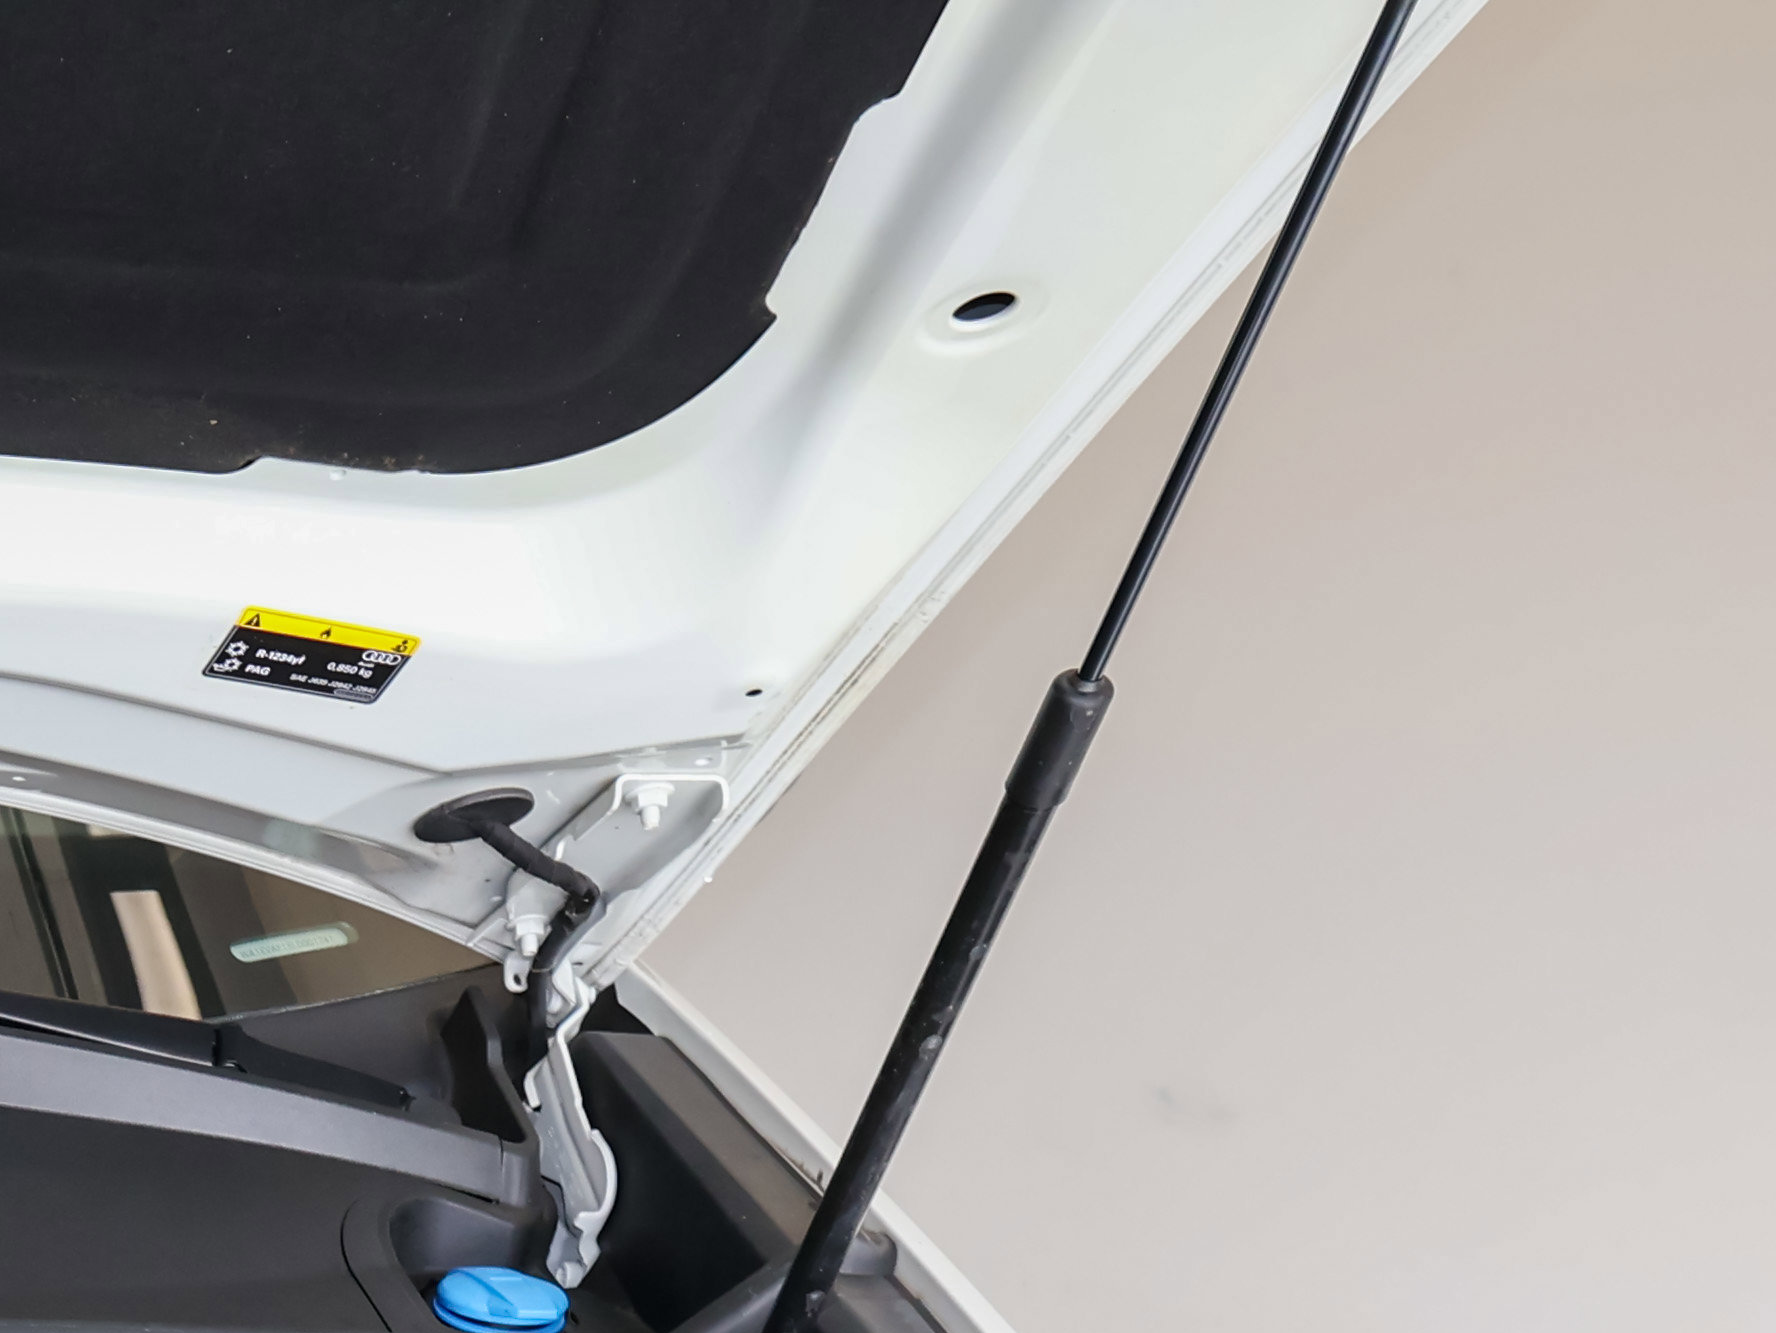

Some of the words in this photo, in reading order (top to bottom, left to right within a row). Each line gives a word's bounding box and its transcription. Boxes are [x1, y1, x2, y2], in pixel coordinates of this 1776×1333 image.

[255, 648, 306, 665] R-1234yf
[245, 664, 271, 676] PAG
[358, 667, 373, 679] kg
